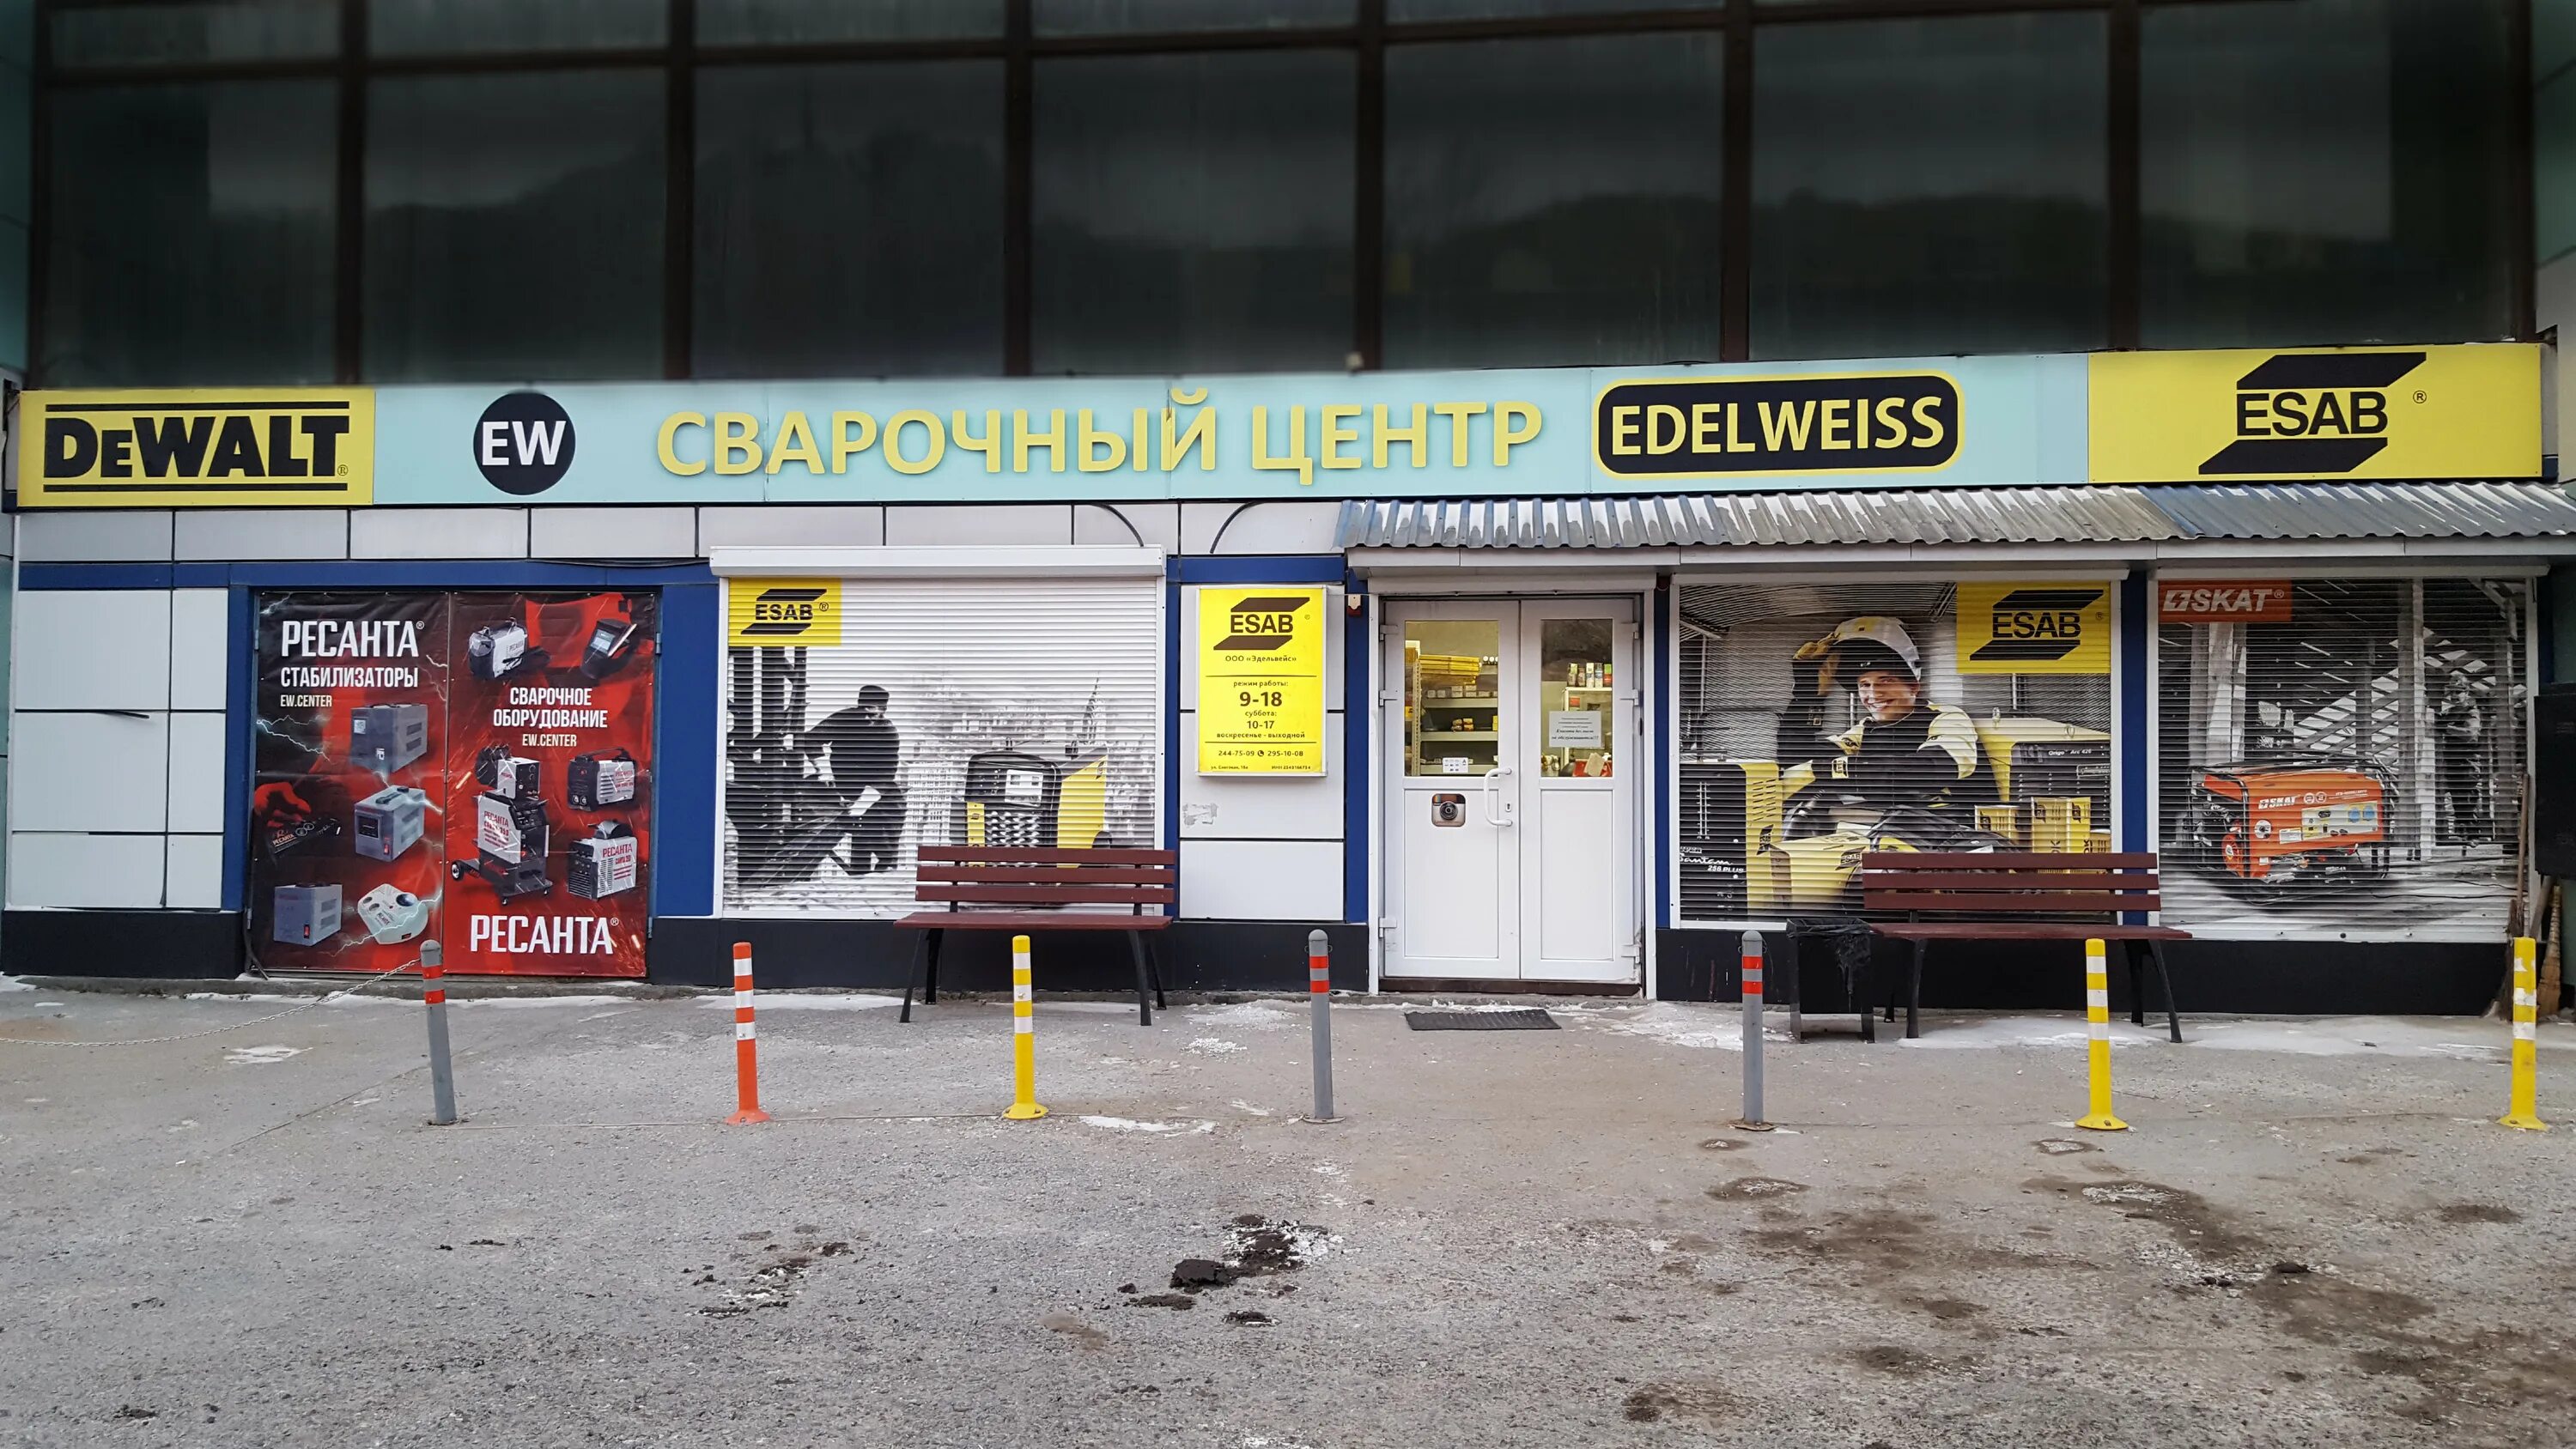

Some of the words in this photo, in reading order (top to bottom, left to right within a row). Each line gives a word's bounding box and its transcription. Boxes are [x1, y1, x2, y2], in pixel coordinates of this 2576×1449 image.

[2236, 391, 2388, 436] ESAB
[658, 388, 1216, 476] СВАРОЧНЫЙ
[1252, 401, 1542, 485] ЦЕНТР
[1612, 396, 1945, 456] EDELWEISS
[482, 421, 566, 465] EW
[2192, 589, 2272, 612] SKAT
[755, 603, 813, 621] ESAB
[1230, 613, 1294, 634] ESAB
[1992, 611, 2081, 639] ESAB
[281, 620, 419, 658] РЕСАНТА
[280, 666, 418, 688] СТАБИЛИЗАТОРЫ
[280, 694, 332, 707] EW.CENTER
[509, 688, 592, 706] СВАРОЧНОЕ
[1239, 691, 1283, 707] 9-18
[493, 708, 608, 729] ОБОРУДОВАНИЕ
[1247, 720, 1275, 730] 10-17
[522, 734, 577, 747] EW.CENTER
[603, 844, 633, 858] РЕСАНТА
[470, 914, 614, 955] РЕСАНТА
